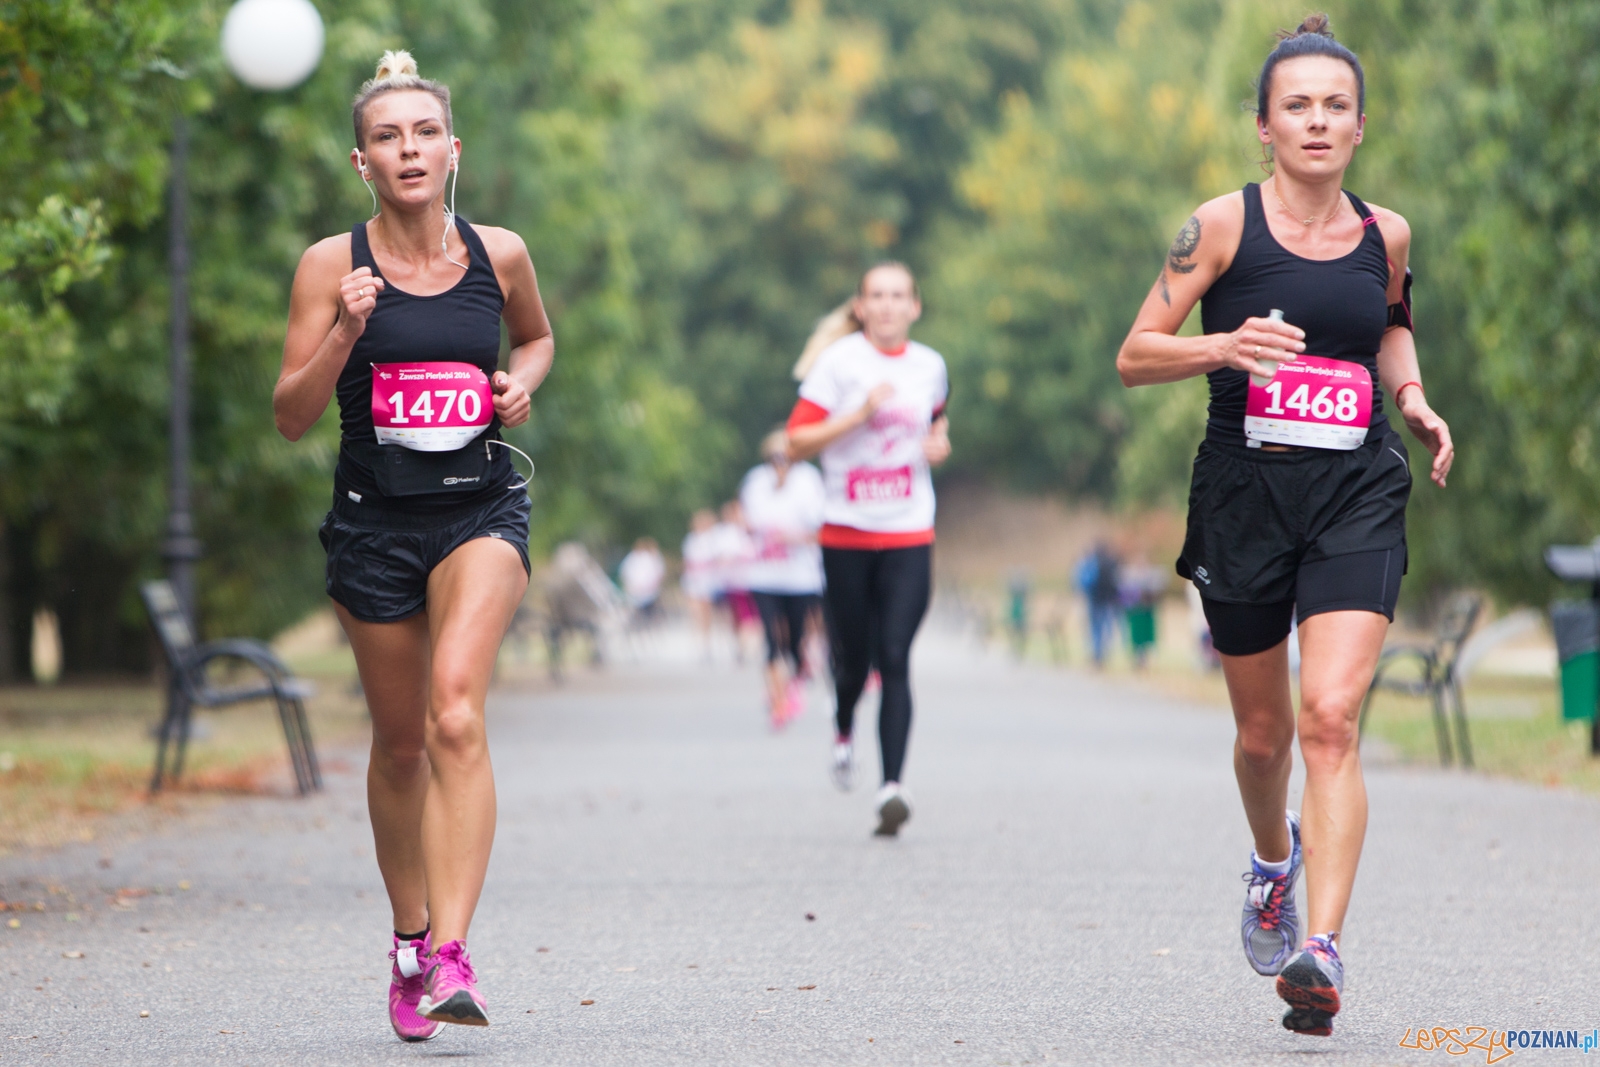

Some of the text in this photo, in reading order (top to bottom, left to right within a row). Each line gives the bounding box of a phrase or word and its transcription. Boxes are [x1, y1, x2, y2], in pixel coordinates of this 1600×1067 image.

[399, 371, 471, 381] Zawsze Pier(w)si 2016
[1278, 363, 1305, 373] Zawsze
[1334, 369, 1353, 379] 2016
[388, 388, 482, 424] 1470
[1264, 381, 1358, 422] 1468
